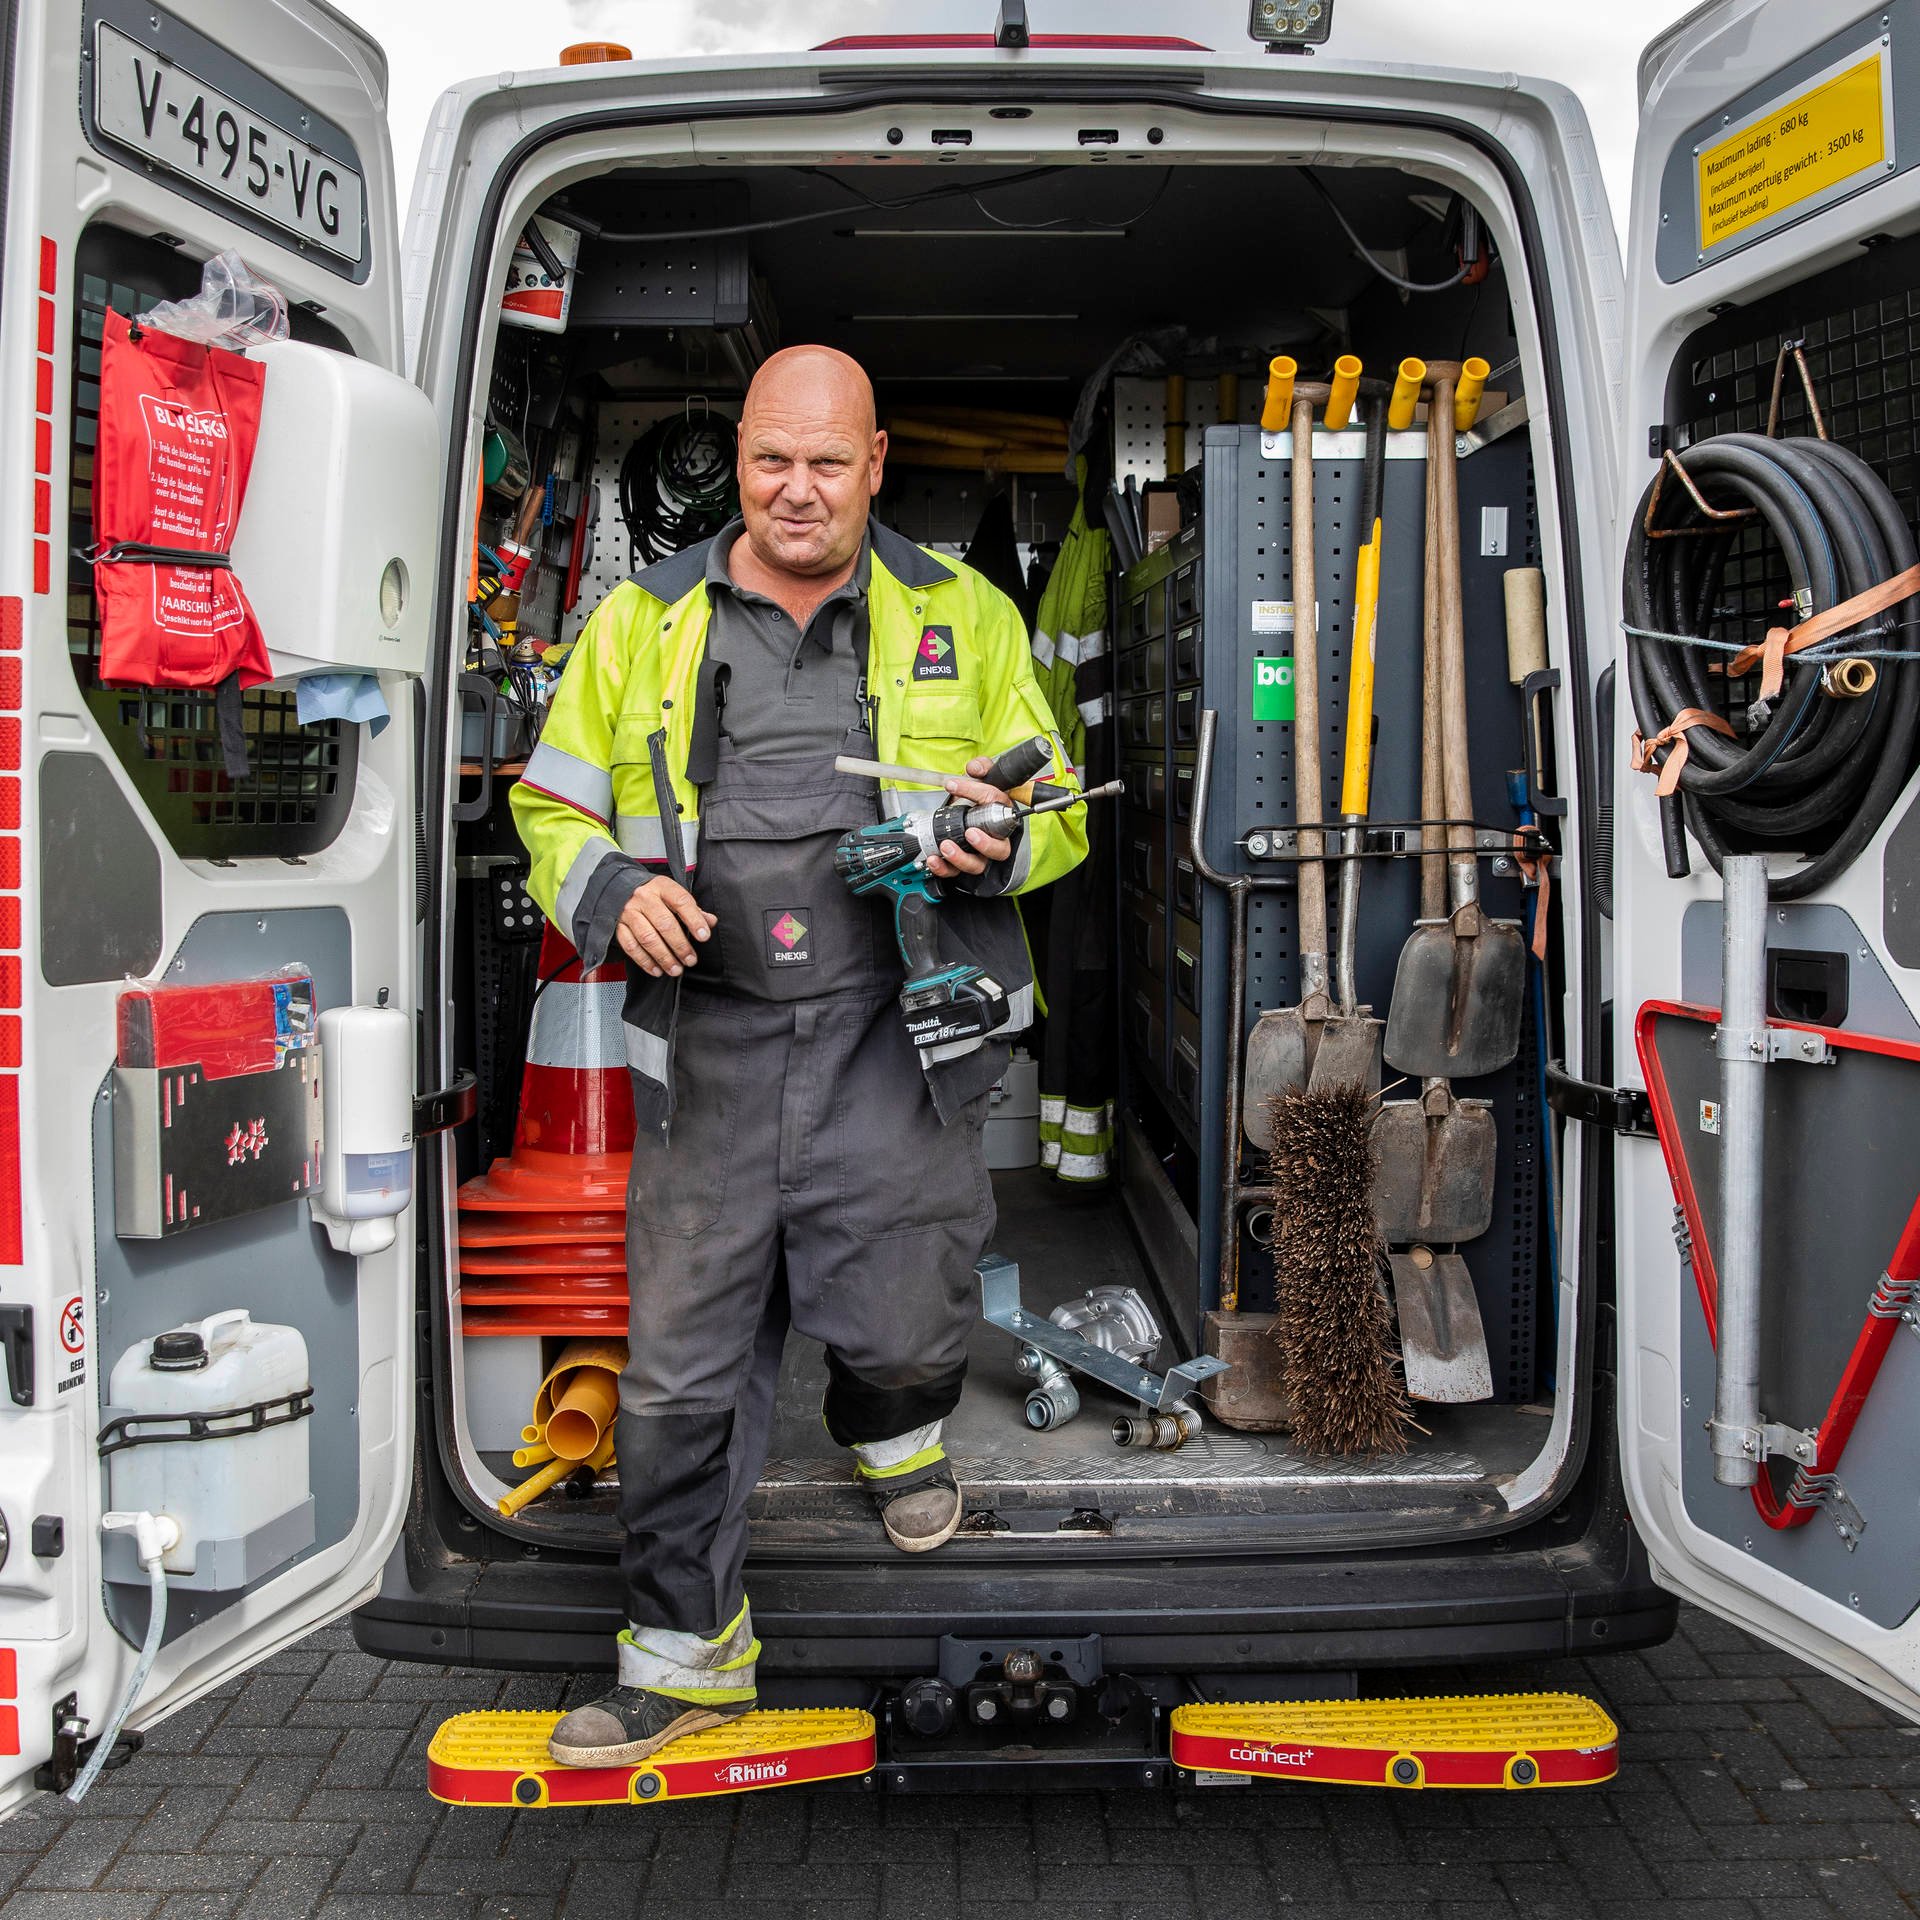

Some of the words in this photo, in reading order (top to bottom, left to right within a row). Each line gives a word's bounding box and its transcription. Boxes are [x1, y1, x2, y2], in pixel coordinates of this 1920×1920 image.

[134, 57, 340, 236] V-495-VG
[1707, 149, 1745, 176] Maximum
[1746, 134, 1772, 154] lading
[1780, 118, 1796, 136] 680
[1798, 112, 1809, 126] kg
[1708, 190, 1746, 218] Maximum
[1748, 171, 1782, 196] voertuig
[1783, 151, 1818, 180] gewicht
[1827, 133, 1851, 156] 3500
[1852, 128, 1864, 143] kg
[1710, 171, 1737, 197] (inclusief
[1738, 157, 1766, 180] berijder)
[1711, 210, 1739, 235] (inclusief
[1739, 195, 1769, 219] belading)
[920, 665, 952, 675] ENEXIS
[1257, 662, 1295, 686] bo
[775, 951, 808, 961] ENEXIS
[729, 1763, 787, 1784] Rhino
